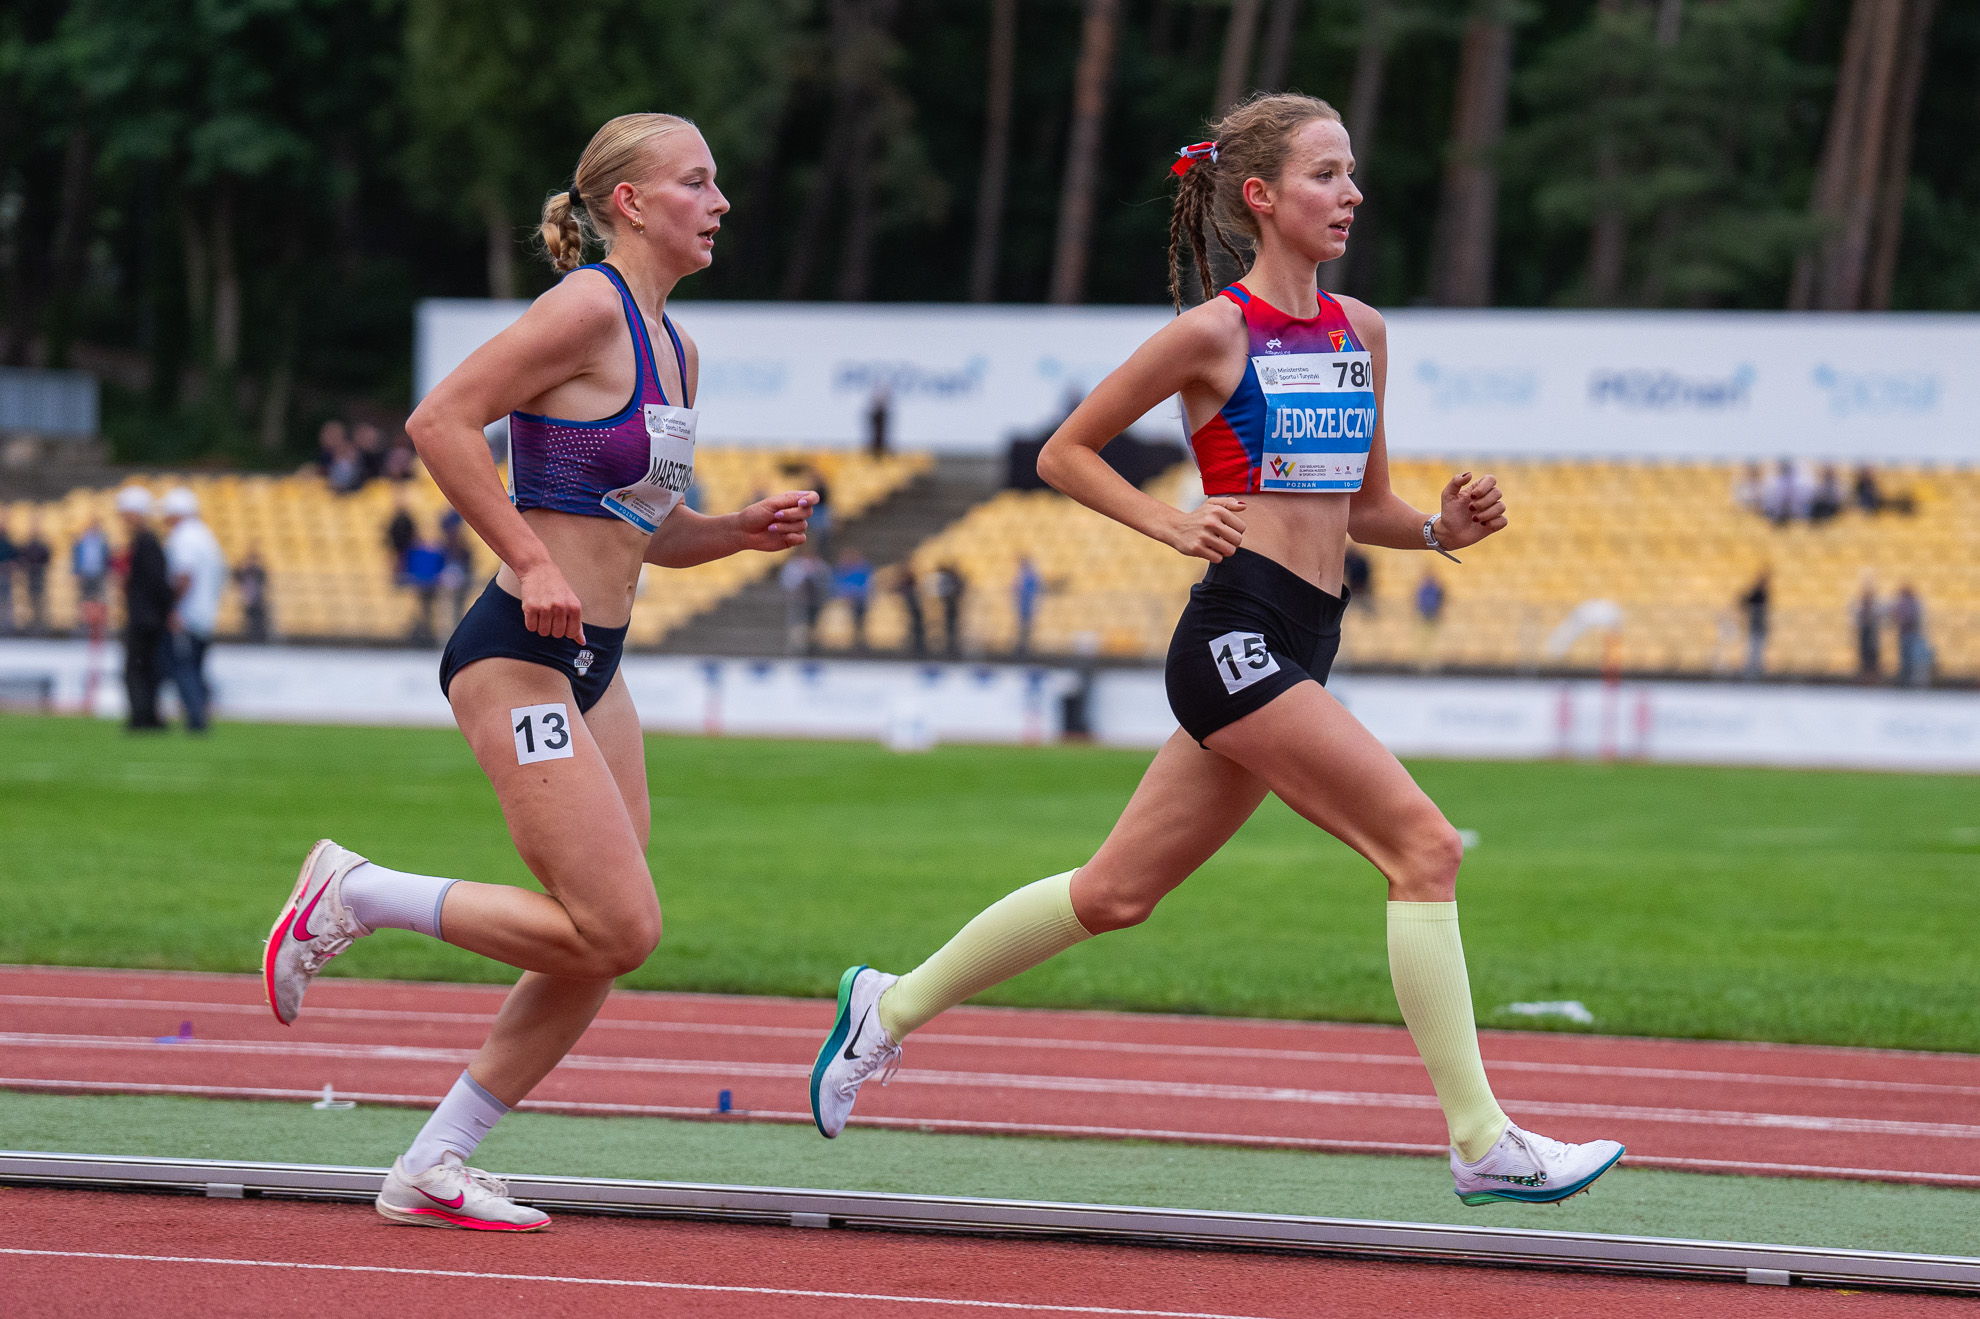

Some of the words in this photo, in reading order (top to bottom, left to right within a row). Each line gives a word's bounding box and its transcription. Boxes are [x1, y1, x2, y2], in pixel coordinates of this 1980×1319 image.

[1332, 361, 1371, 388] 780
[1217, 637, 1270, 681] 15
[515, 712, 569, 753] 13
